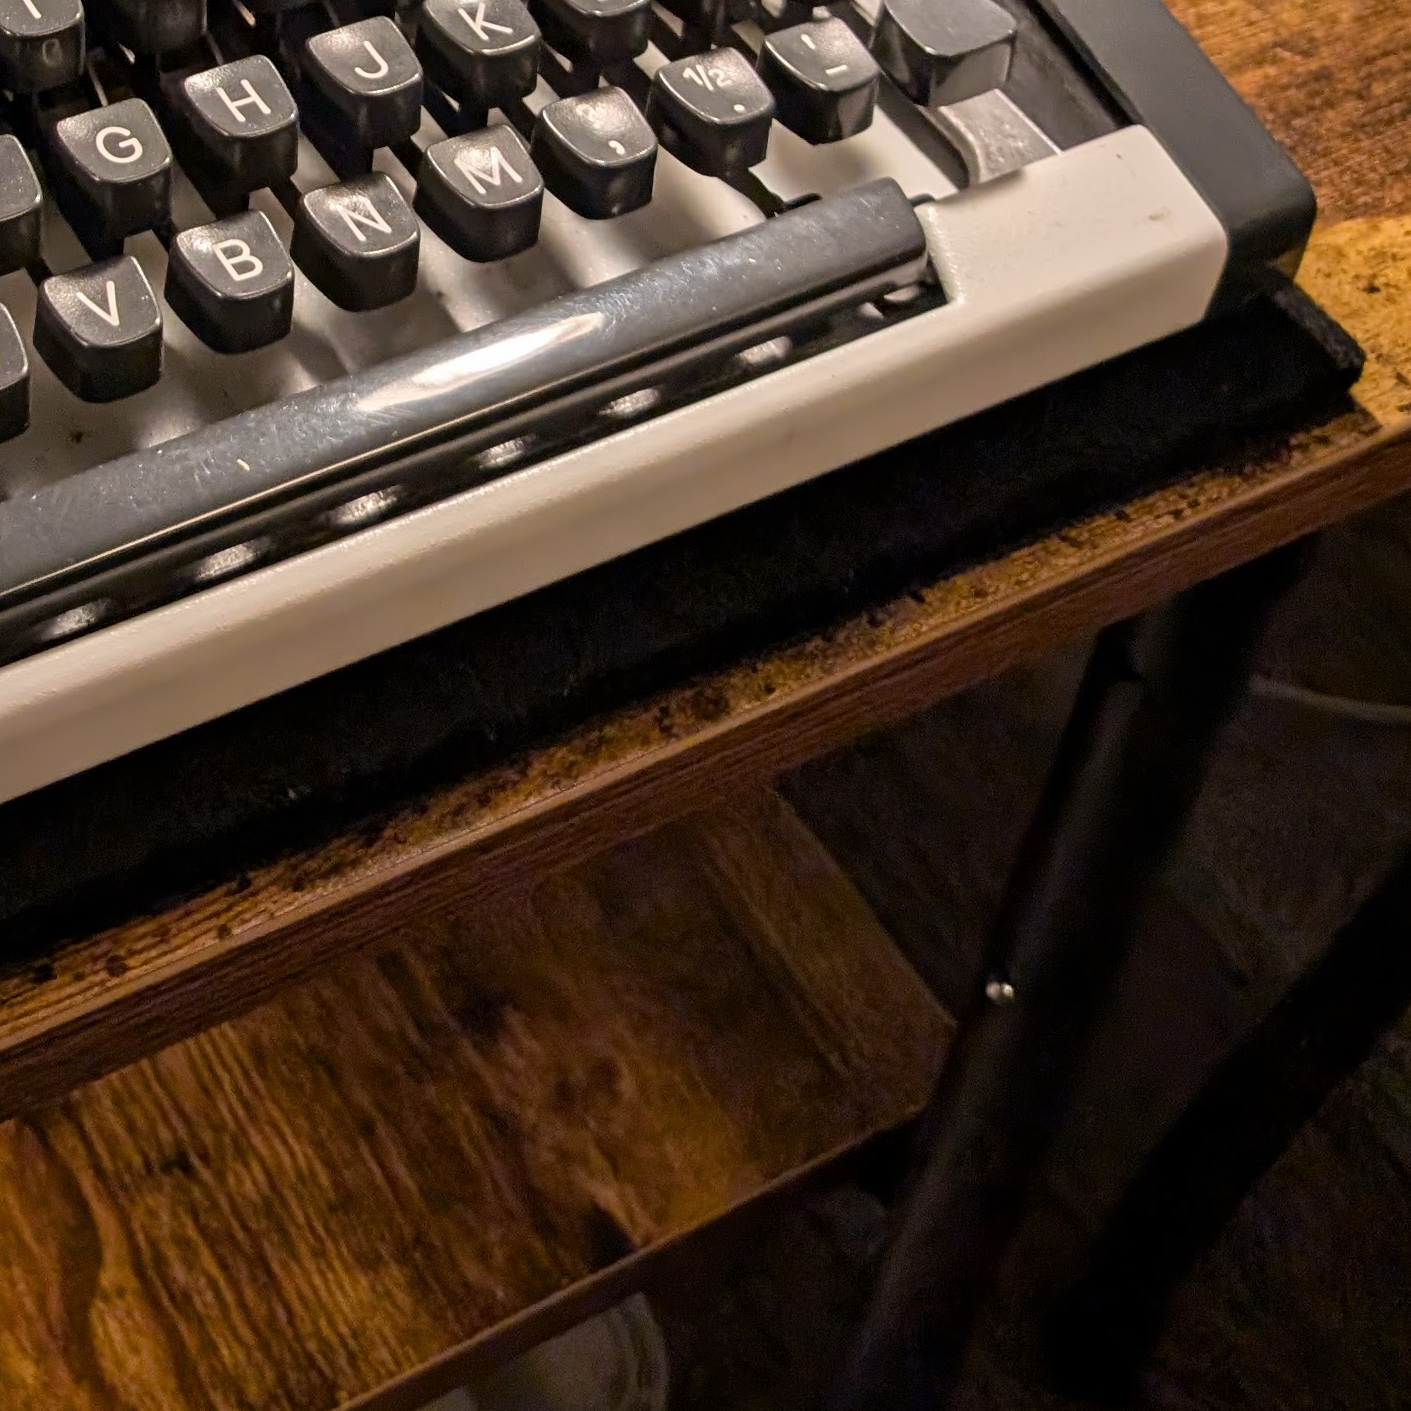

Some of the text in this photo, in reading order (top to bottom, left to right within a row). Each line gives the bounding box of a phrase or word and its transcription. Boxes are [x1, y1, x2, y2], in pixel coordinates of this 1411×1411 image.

[456, 1, 513, 41] K
[354, 40, 389, 79] J
[216, 78, 272, 122] H
[95, 125, 143, 164] G
[453, 145, 523, 195] M
[335, 198, 393, 242] N
[212, 238, 264, 282] B
[75, 280, 121, 327] V
